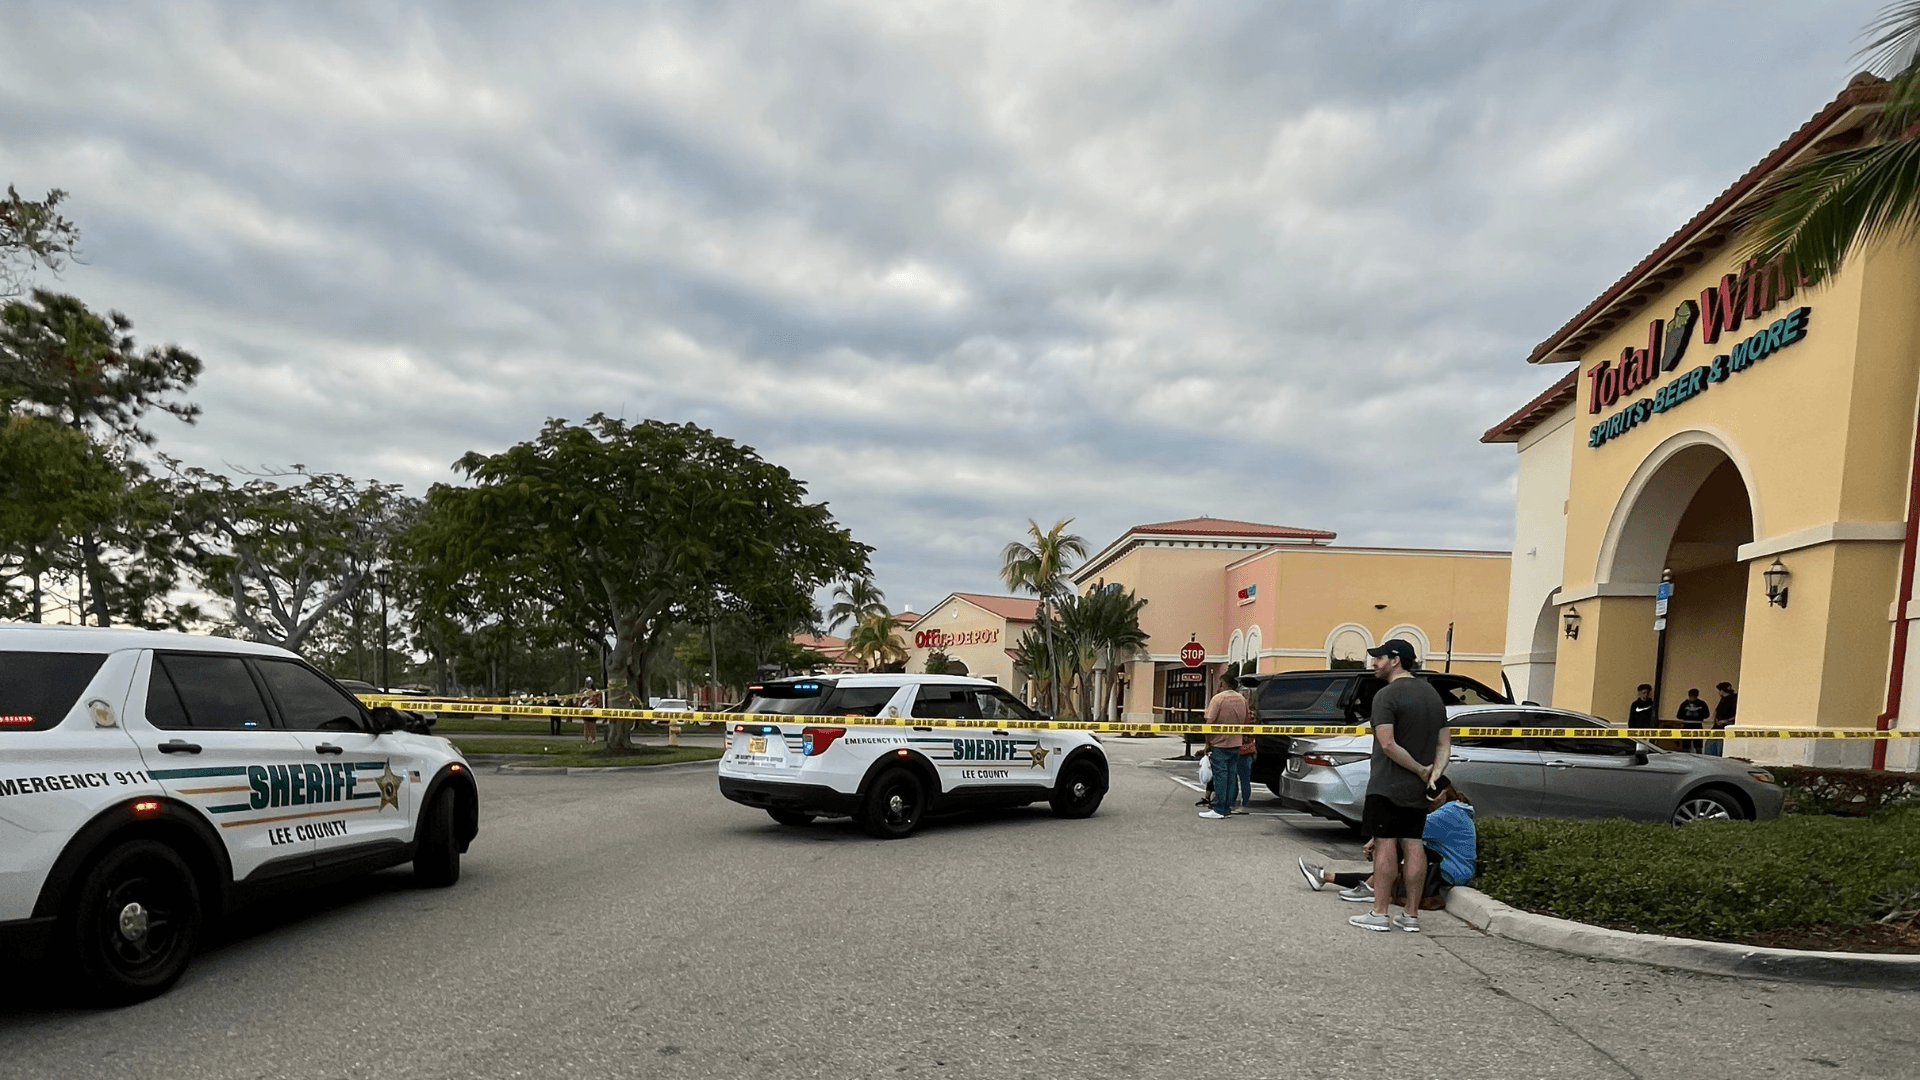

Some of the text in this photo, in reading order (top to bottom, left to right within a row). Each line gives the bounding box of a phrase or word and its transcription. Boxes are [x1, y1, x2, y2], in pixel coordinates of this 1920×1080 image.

[1587, 254, 1814, 414] Total Win
[1588, 307, 1811, 448] SPIRITS BEER & MORE
[956, 628, 1000, 646] DEPOT
[1181, 649, 1204, 659] STOP
[844, 737, 891, 745] EMERGENCY
[953, 739, 1018, 761] SHERIFF
[0, 771, 148, 797] MERGENCY 911
[247, 762, 358, 810] SHERIFF
[962, 770, 1009, 779] LEE COUNTY
[268, 820, 348, 846] LEE COUNTY
